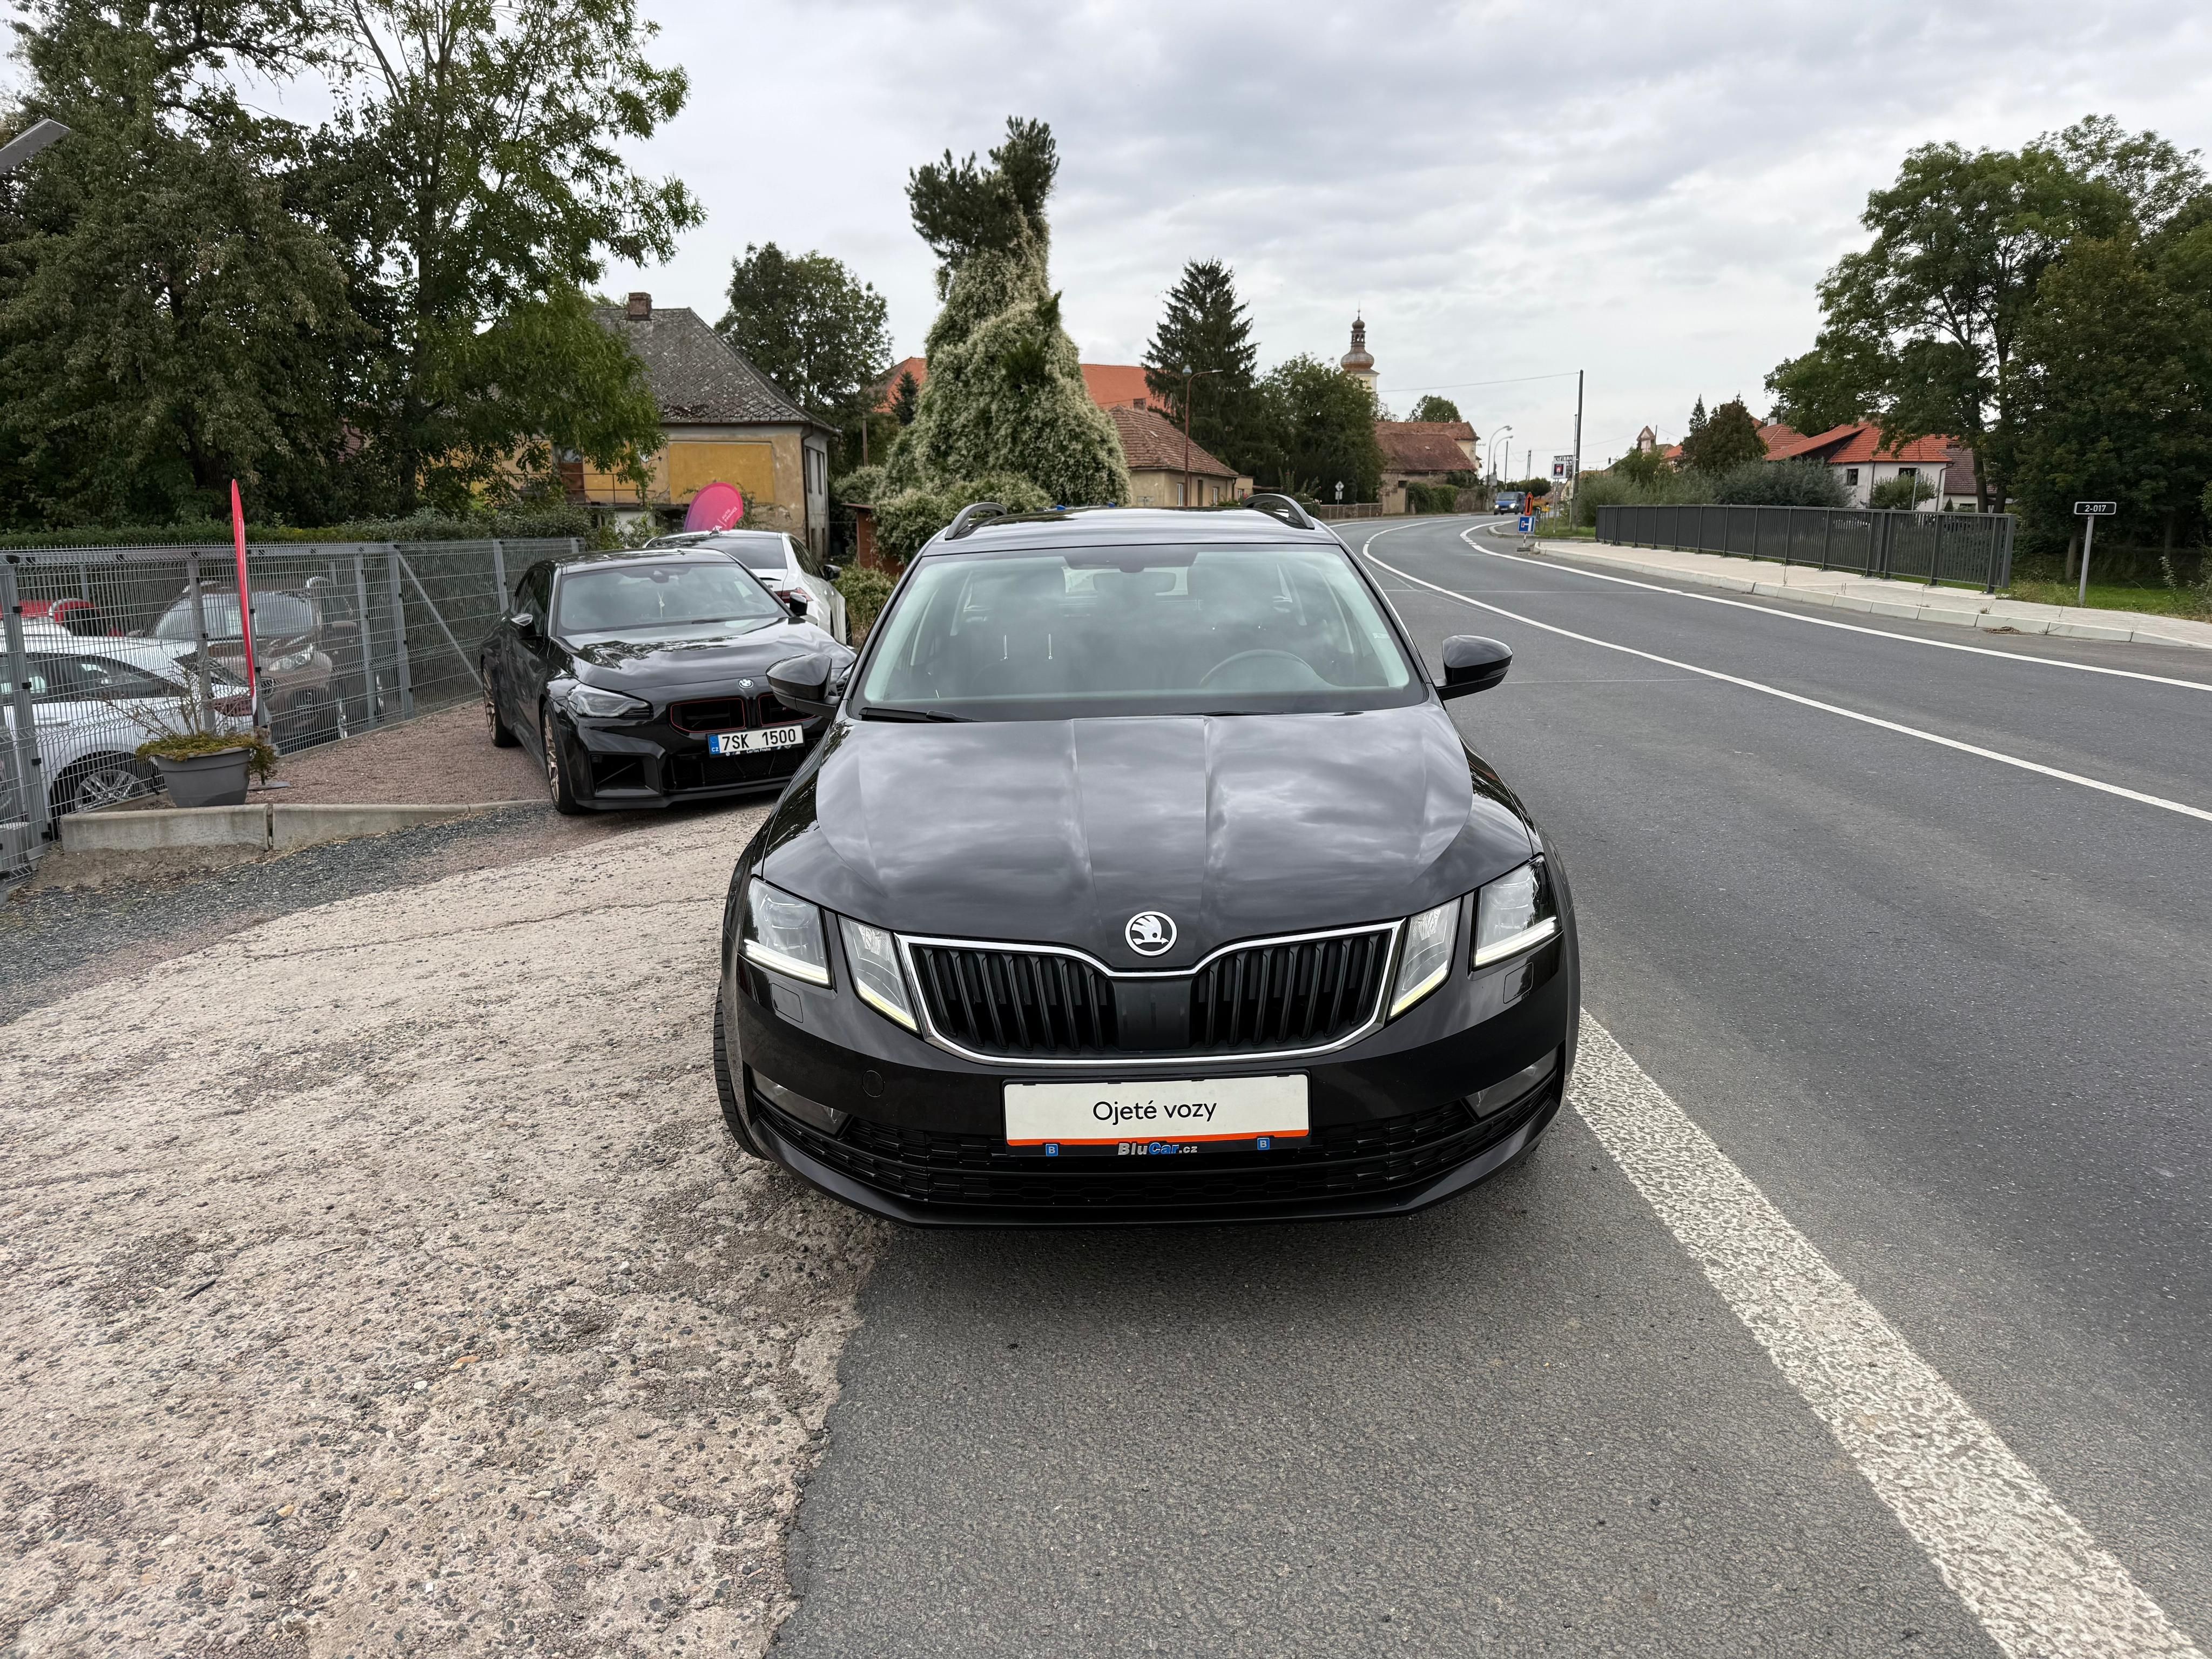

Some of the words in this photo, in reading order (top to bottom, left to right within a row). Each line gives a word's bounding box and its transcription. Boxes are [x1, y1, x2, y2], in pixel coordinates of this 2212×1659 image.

[722, 734, 750, 751] 7SK
[762, 729, 796, 746] 1500
[1092, 1100, 1157, 1125] Ojeté
[1163, 1102, 1217, 1122] vozy
[1118, 1142, 1198, 1155] BluCar.cz
[1260, 1140, 1267, 1148] B
